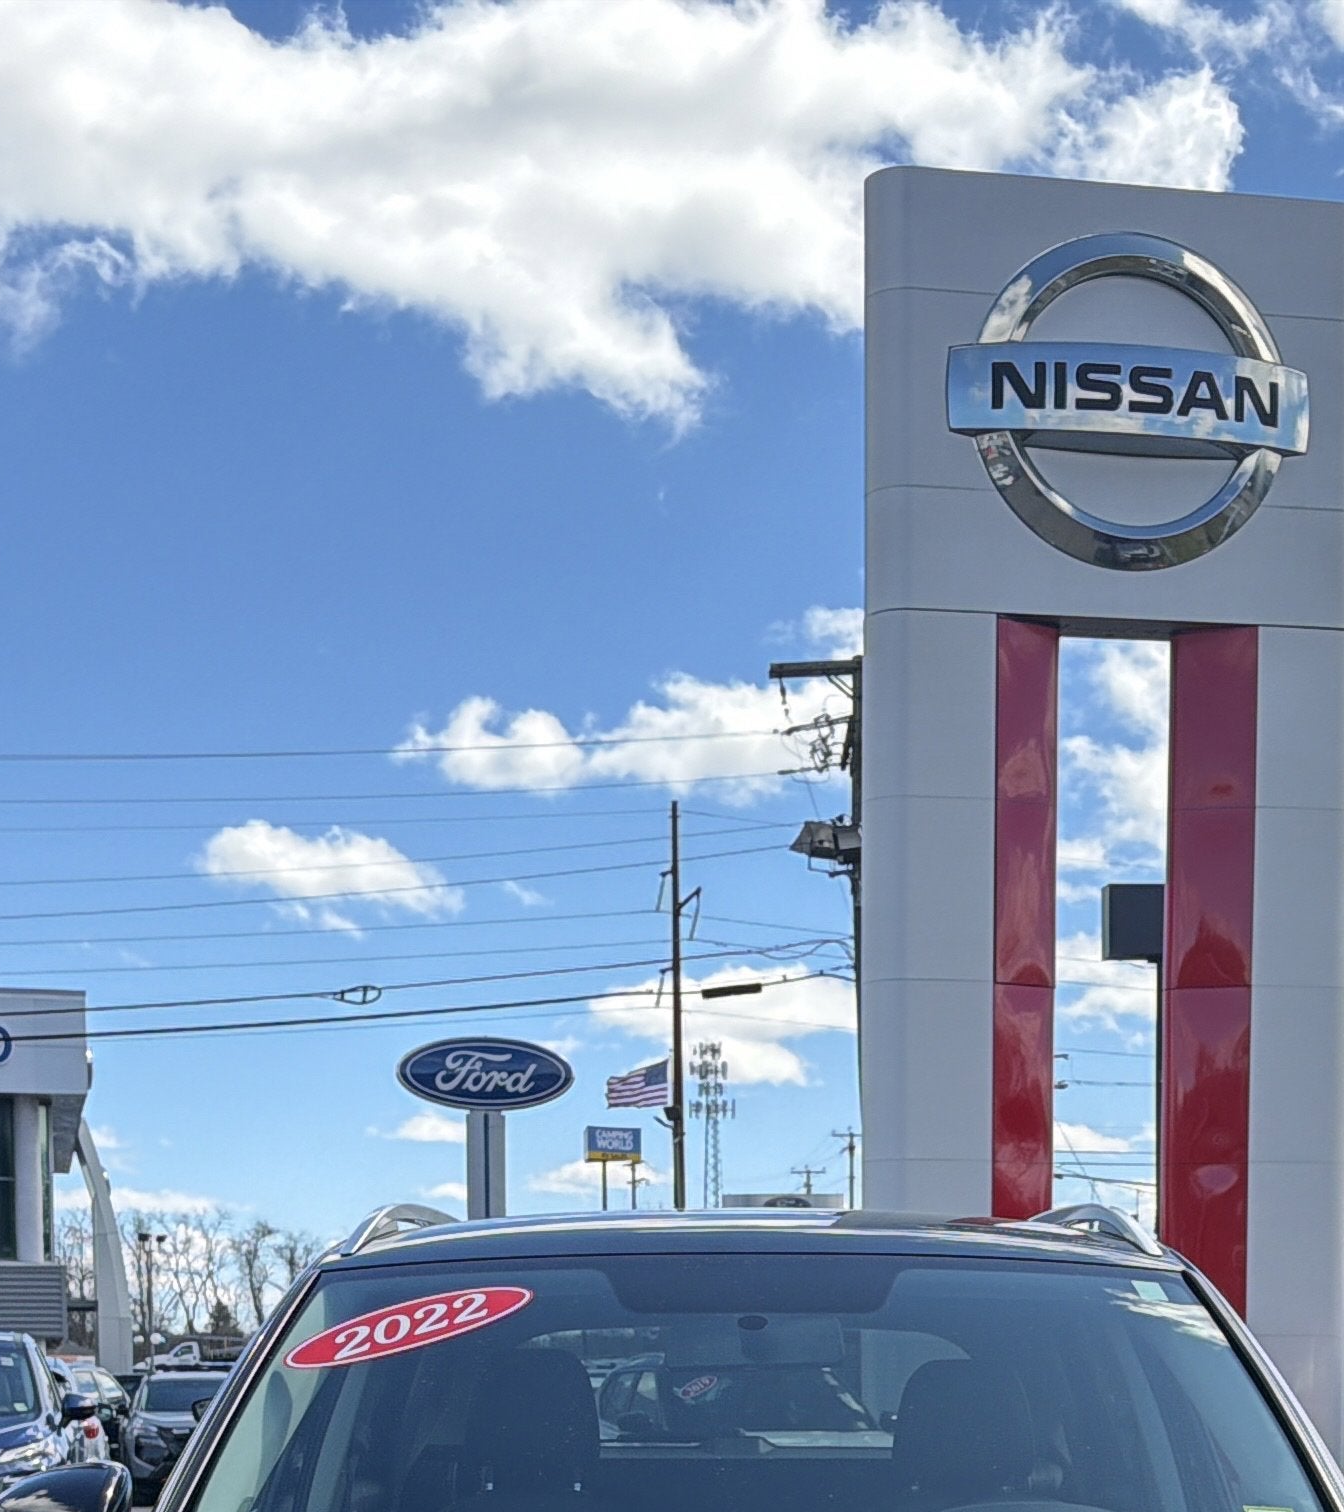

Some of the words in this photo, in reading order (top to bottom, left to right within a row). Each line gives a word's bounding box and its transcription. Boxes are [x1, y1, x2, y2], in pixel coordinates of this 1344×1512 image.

[990, 360, 1280, 429] NISSAN
[435, 1050, 538, 1094] Ford
[596, 1139, 634, 1151] WORLD
[334, 1293, 488, 1361] 2022
